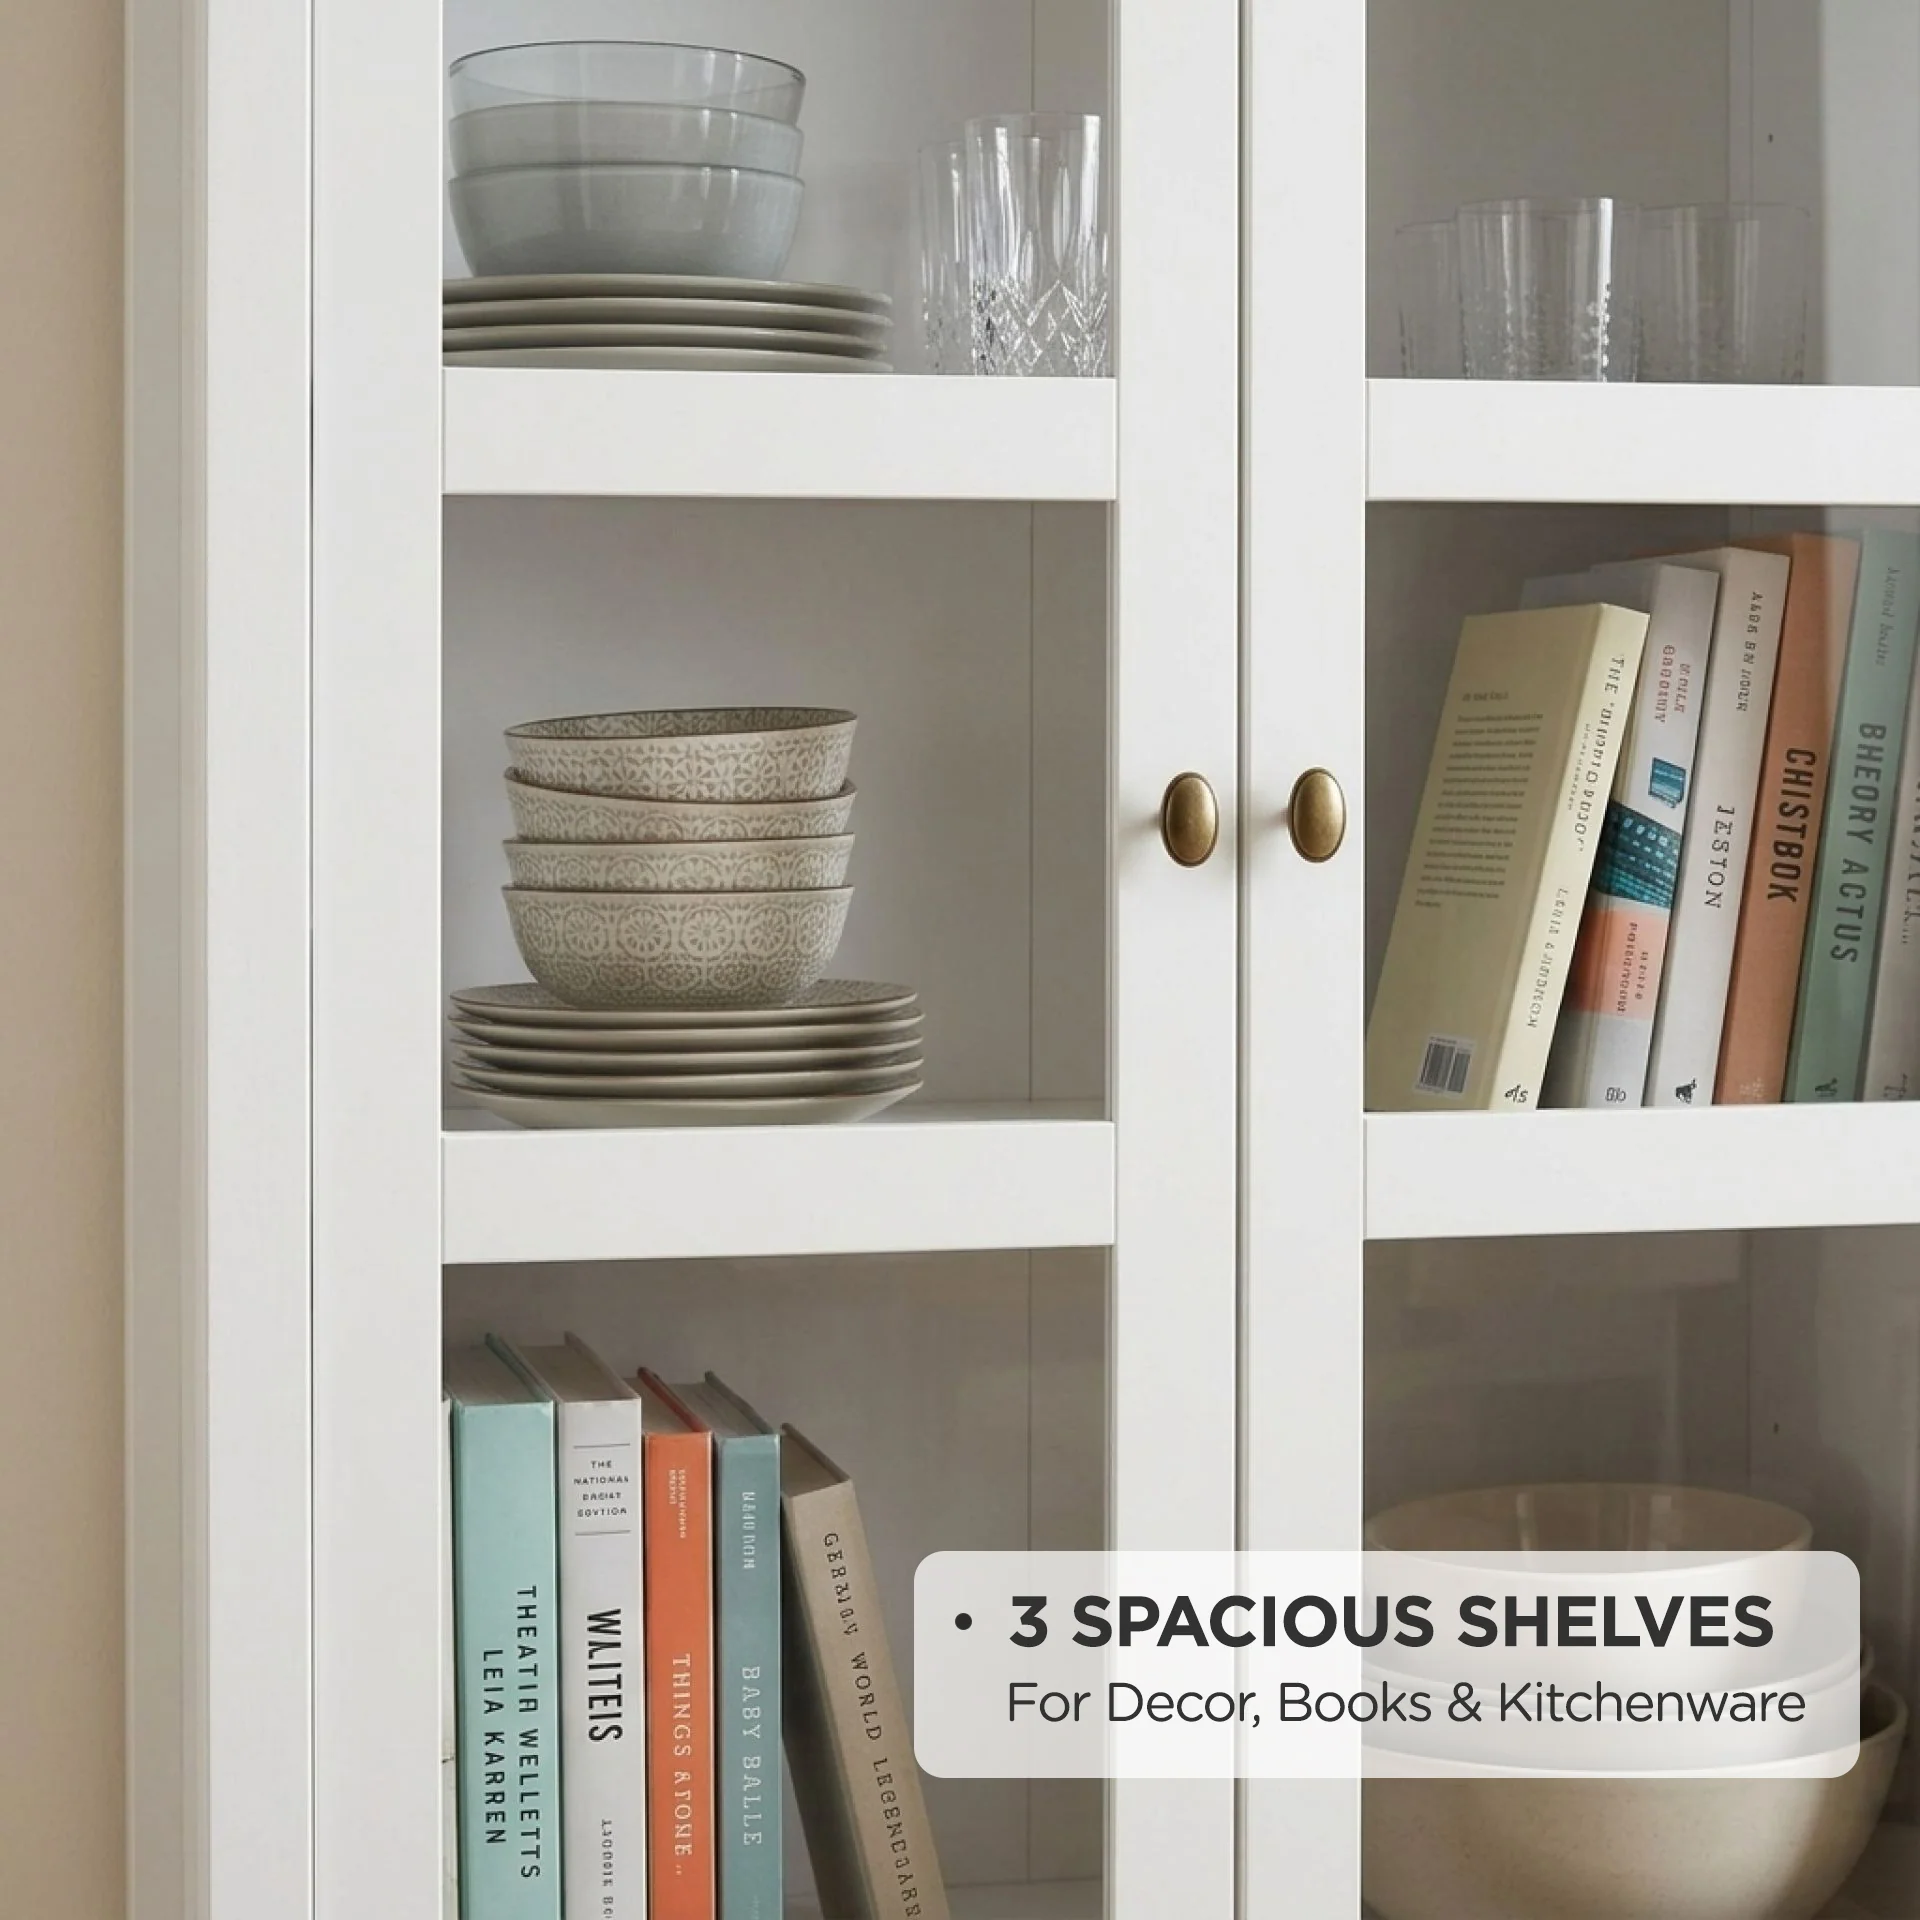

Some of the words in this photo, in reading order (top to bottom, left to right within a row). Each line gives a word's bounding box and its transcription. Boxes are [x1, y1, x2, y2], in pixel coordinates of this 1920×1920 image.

[1767, 748, 1817, 902] CHISTBOK
[1829, 858, 1869, 963] ACTUS
[483, 1649, 505, 1715] LEIA
[672, 1653, 692, 1756] THINGS
[742, 1666, 762, 1739] BABY
[850, 1652, 882, 1741] WORLD
[484, 1731, 507, 1844] KARREN
[518, 1728, 542, 1879] WELLETTS
[742, 1755, 763, 1846] BALLE
